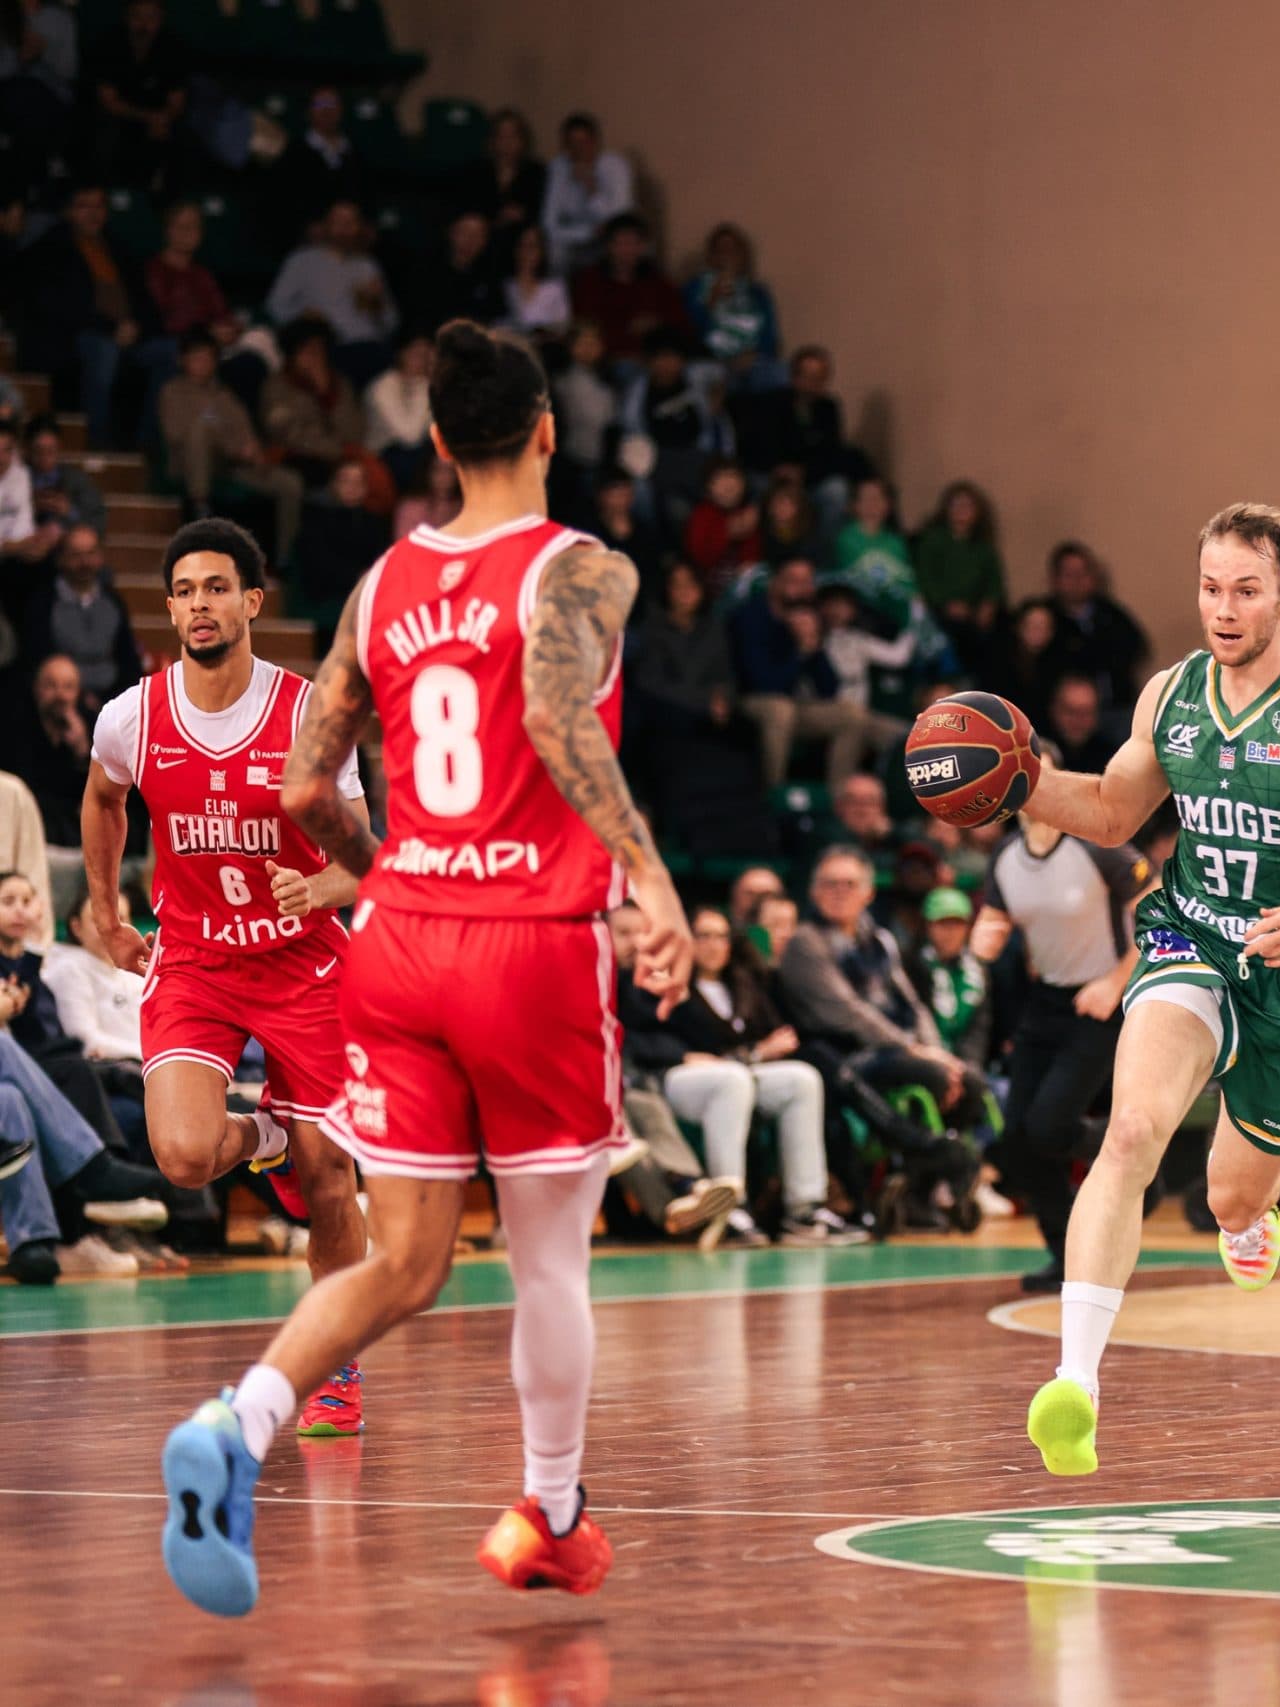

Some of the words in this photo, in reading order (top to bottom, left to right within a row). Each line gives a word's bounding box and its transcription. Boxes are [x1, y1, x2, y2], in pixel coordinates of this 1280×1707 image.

[384, 599, 454, 666] HILL
[410, 664, 484, 818] 8
[205, 798, 238, 817] ELAN
[168, 813, 281, 857] CHALON
[219, 866, 252, 906] 6
[1196, 844, 1258, 900] 37
